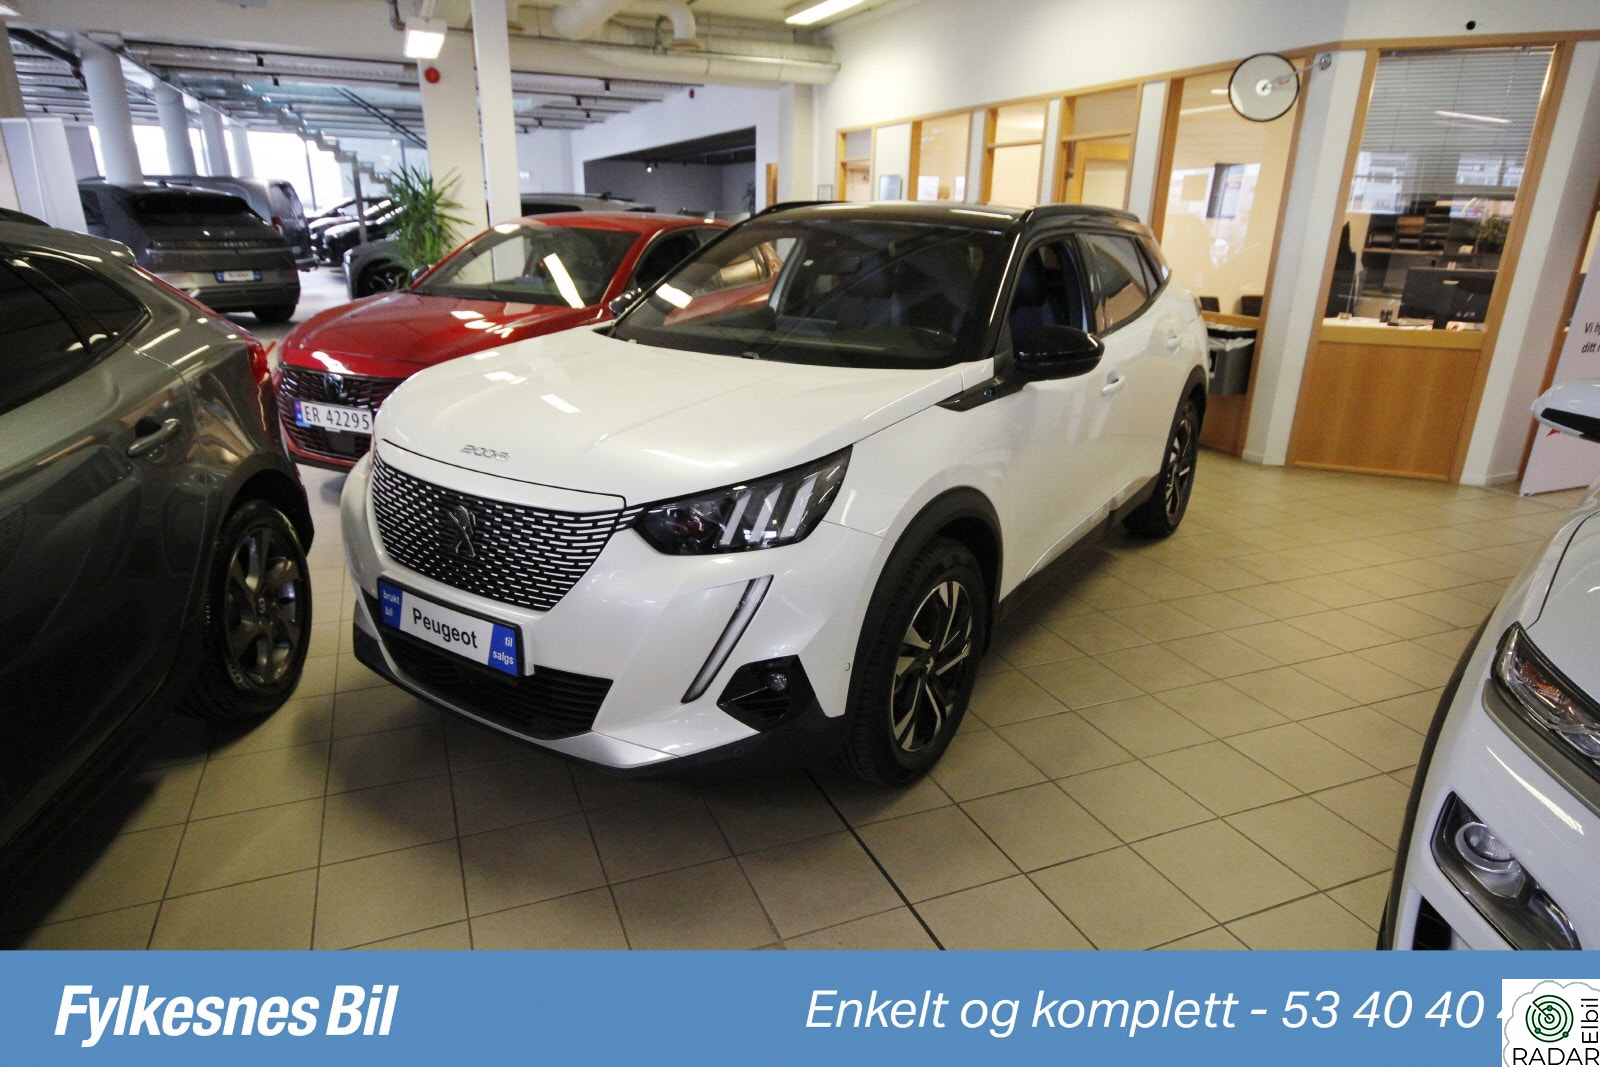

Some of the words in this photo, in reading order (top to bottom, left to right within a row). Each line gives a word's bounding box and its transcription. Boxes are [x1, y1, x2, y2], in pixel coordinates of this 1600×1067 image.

[1585, 322, 1594, 333] Vi
[1581, 342, 1596, 353] ditt
[304, 405, 320, 422] ER
[326, 409, 370, 430] 42295
[383, 589, 400, 605] brukt
[384, 606, 394, 617] bil
[412, 607, 478, 649] Peugeot
[504, 636, 513, 648] til
[492, 650, 514, 665] salgs
